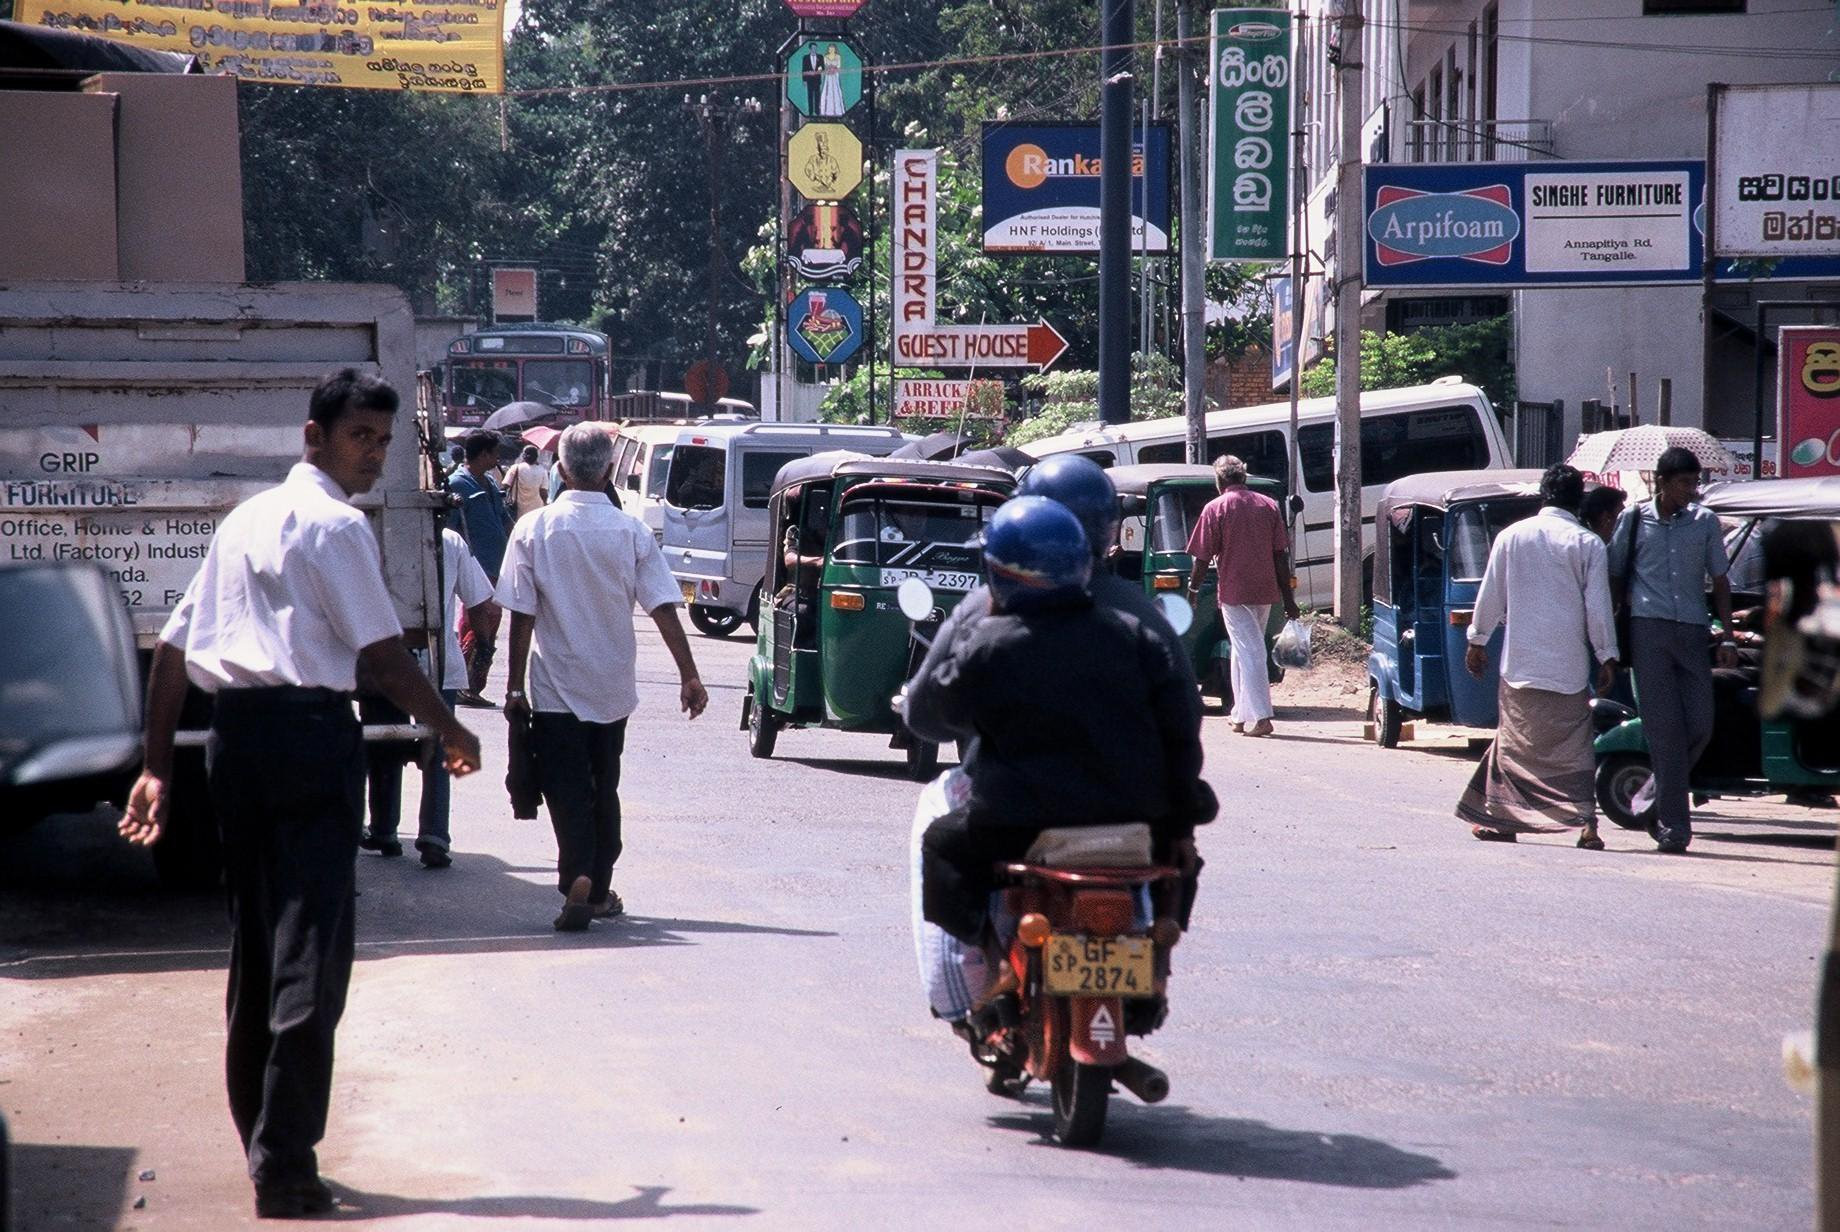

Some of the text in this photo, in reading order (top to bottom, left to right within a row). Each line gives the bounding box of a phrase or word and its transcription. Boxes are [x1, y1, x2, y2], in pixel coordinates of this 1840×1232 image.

[1532, 183, 1683, 207] SINGHE FURNITURE
[1009, 226, 1038, 237] HNF
[1040, 225, 1093, 239] Holdings
[1383, 210, 1505, 247] Arpifoam
[903, 158, 928, 323] CHANDRA
[1564, 239, 1628, 250] Annapitiya
[898, 334, 1028, 360] GUEST HOUSE
[902, 382, 962, 398] ARRACK
[40, 452, 100, 473] GRIP
[1, 519, 216, 537] Office, Home & Hotel
[11, 541, 209, 562] Ltd. (Factory) Indust
[938, 573, 977, 589] 2397
[164, 589, 186, 606] Fa
[1052, 955, 1078, 972] SP
[1079, 966, 1137, 990] 2874
